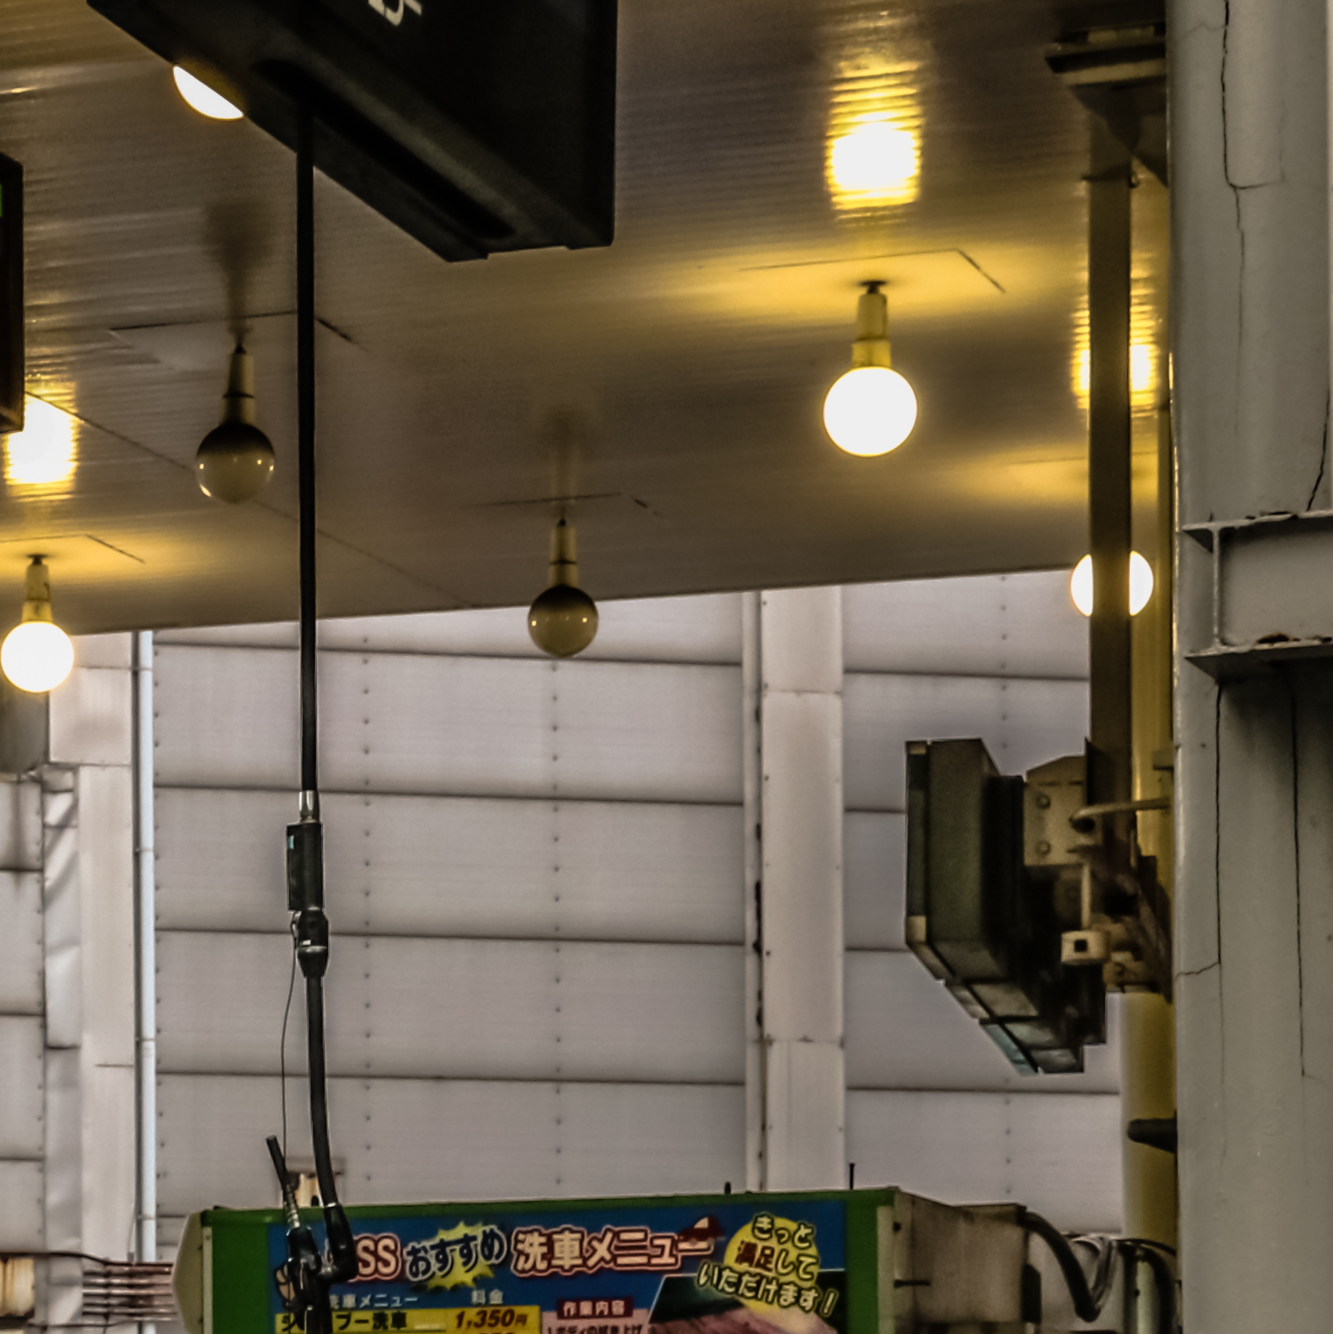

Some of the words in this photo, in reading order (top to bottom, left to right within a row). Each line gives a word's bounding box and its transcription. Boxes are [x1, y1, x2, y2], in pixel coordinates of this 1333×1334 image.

[754, 1215, 811, 1249] きっと
[406, 1228, 507, 1279] おすすめ
[514, 1228, 715, 1273] 洗車メニュー
[735, 1240, 817, 1280] 満足して
[471, 1291, 503, 1305] 料金
[456, 1309, 527, 1329] 1,350円
